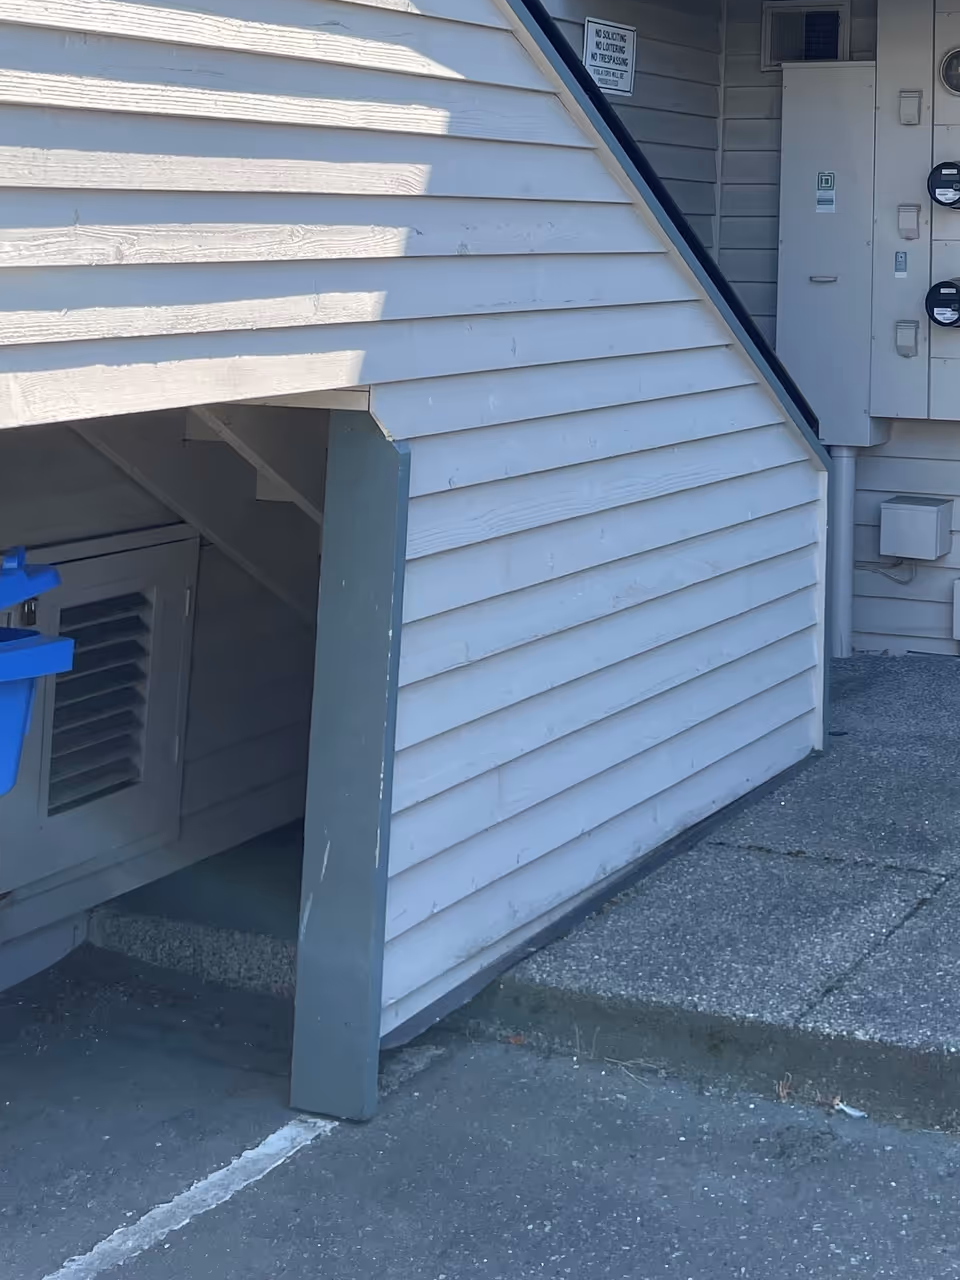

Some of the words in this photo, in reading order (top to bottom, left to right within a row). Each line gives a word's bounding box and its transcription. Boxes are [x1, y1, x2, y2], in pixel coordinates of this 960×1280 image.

[595, 29, 602, 38] NO
[603, 30, 627, 43] SOLICITING
[595, 41, 602, 50] NO
[603, 42, 626, 55] LOITERING
[591, 52, 598, 62] NO
[599, 53, 629, 67] TRESPASSING
